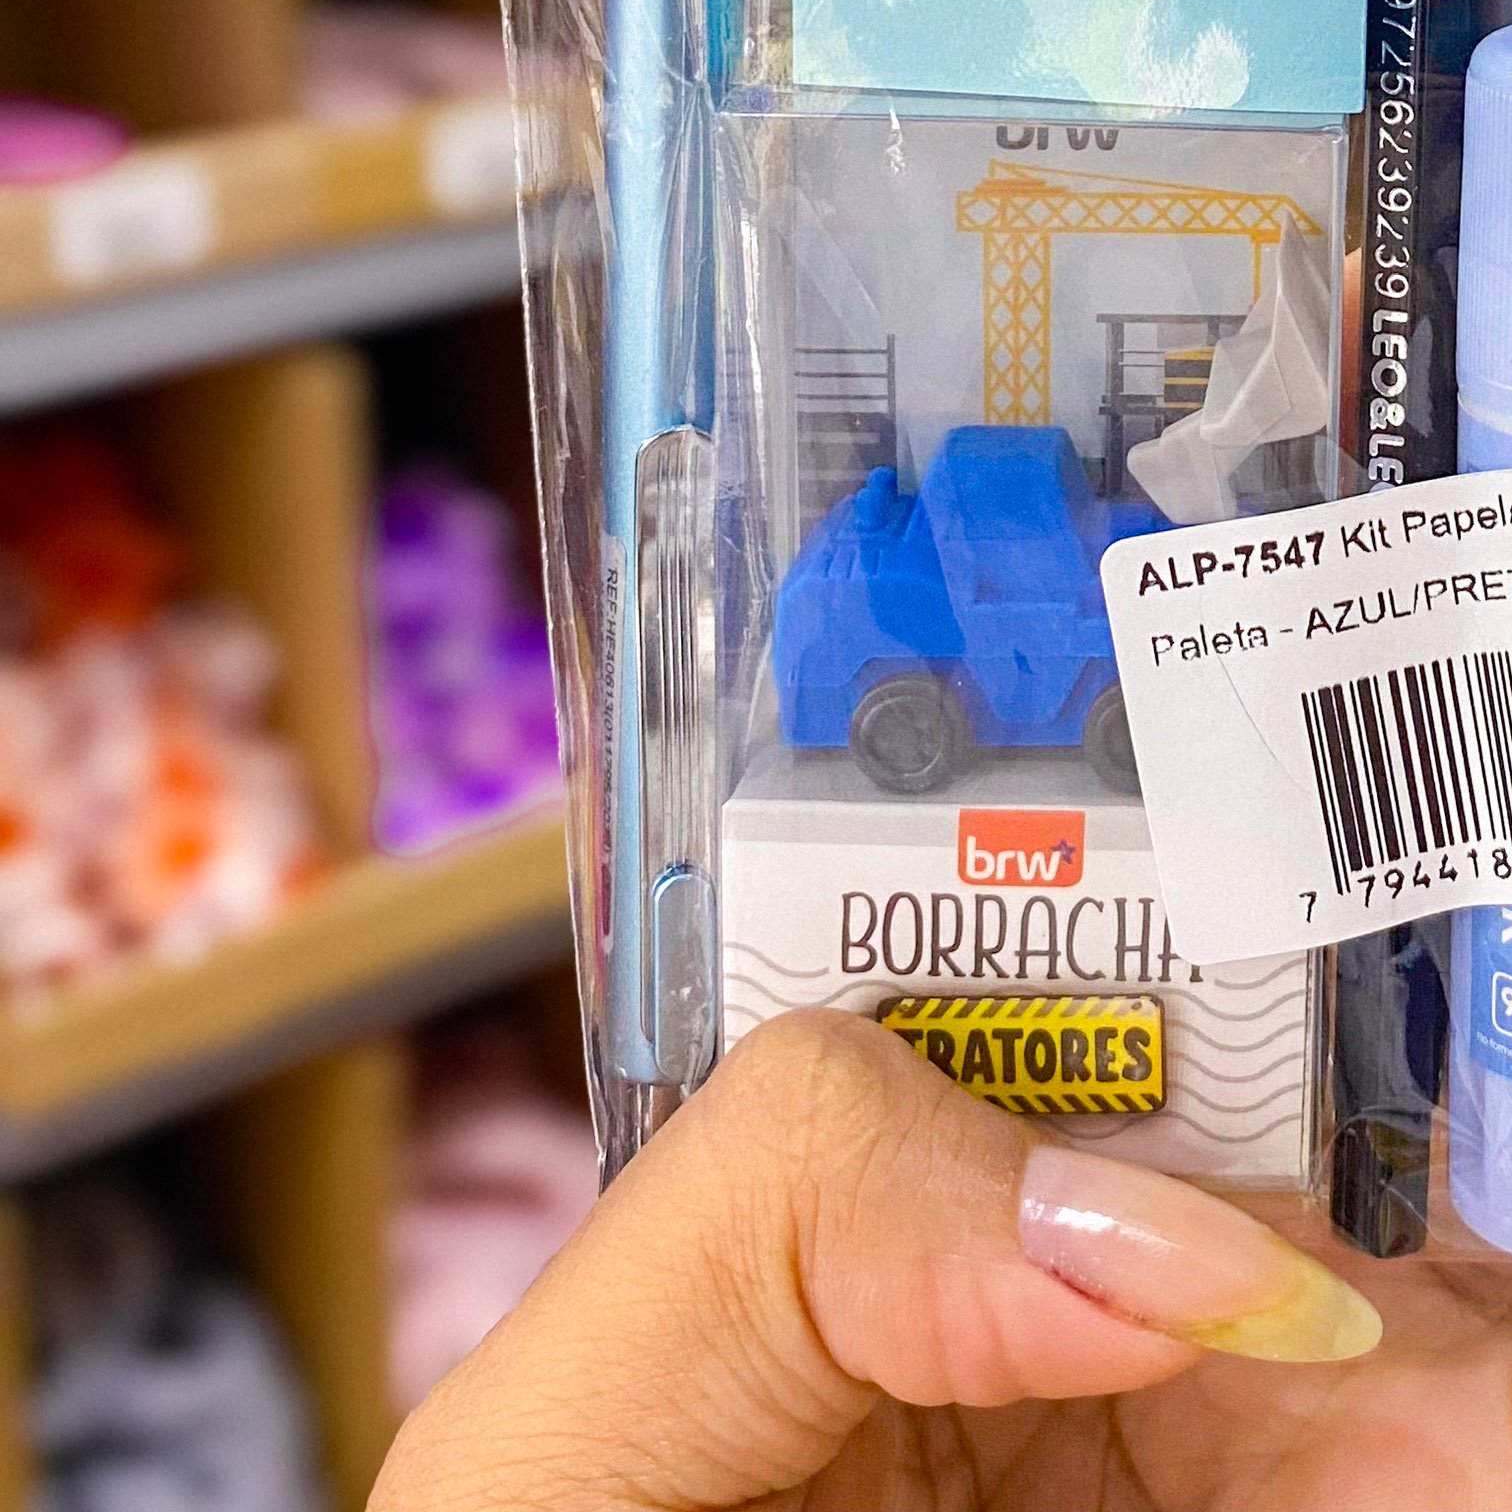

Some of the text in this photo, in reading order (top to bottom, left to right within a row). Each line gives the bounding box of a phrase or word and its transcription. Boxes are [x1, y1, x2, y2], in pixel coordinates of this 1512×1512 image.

[1367, 308, 1409, 491] LEO&LE
[1137, 532, 1326, 597] ALP-7547
[1340, 521, 1393, 557] Kit
[1150, 620, 1270, 668] Paleta
[965, 835, 1062, 881] brw
[1299, 891, 1317, 923] 7
[1358, 845, 1511, 909] 794418
